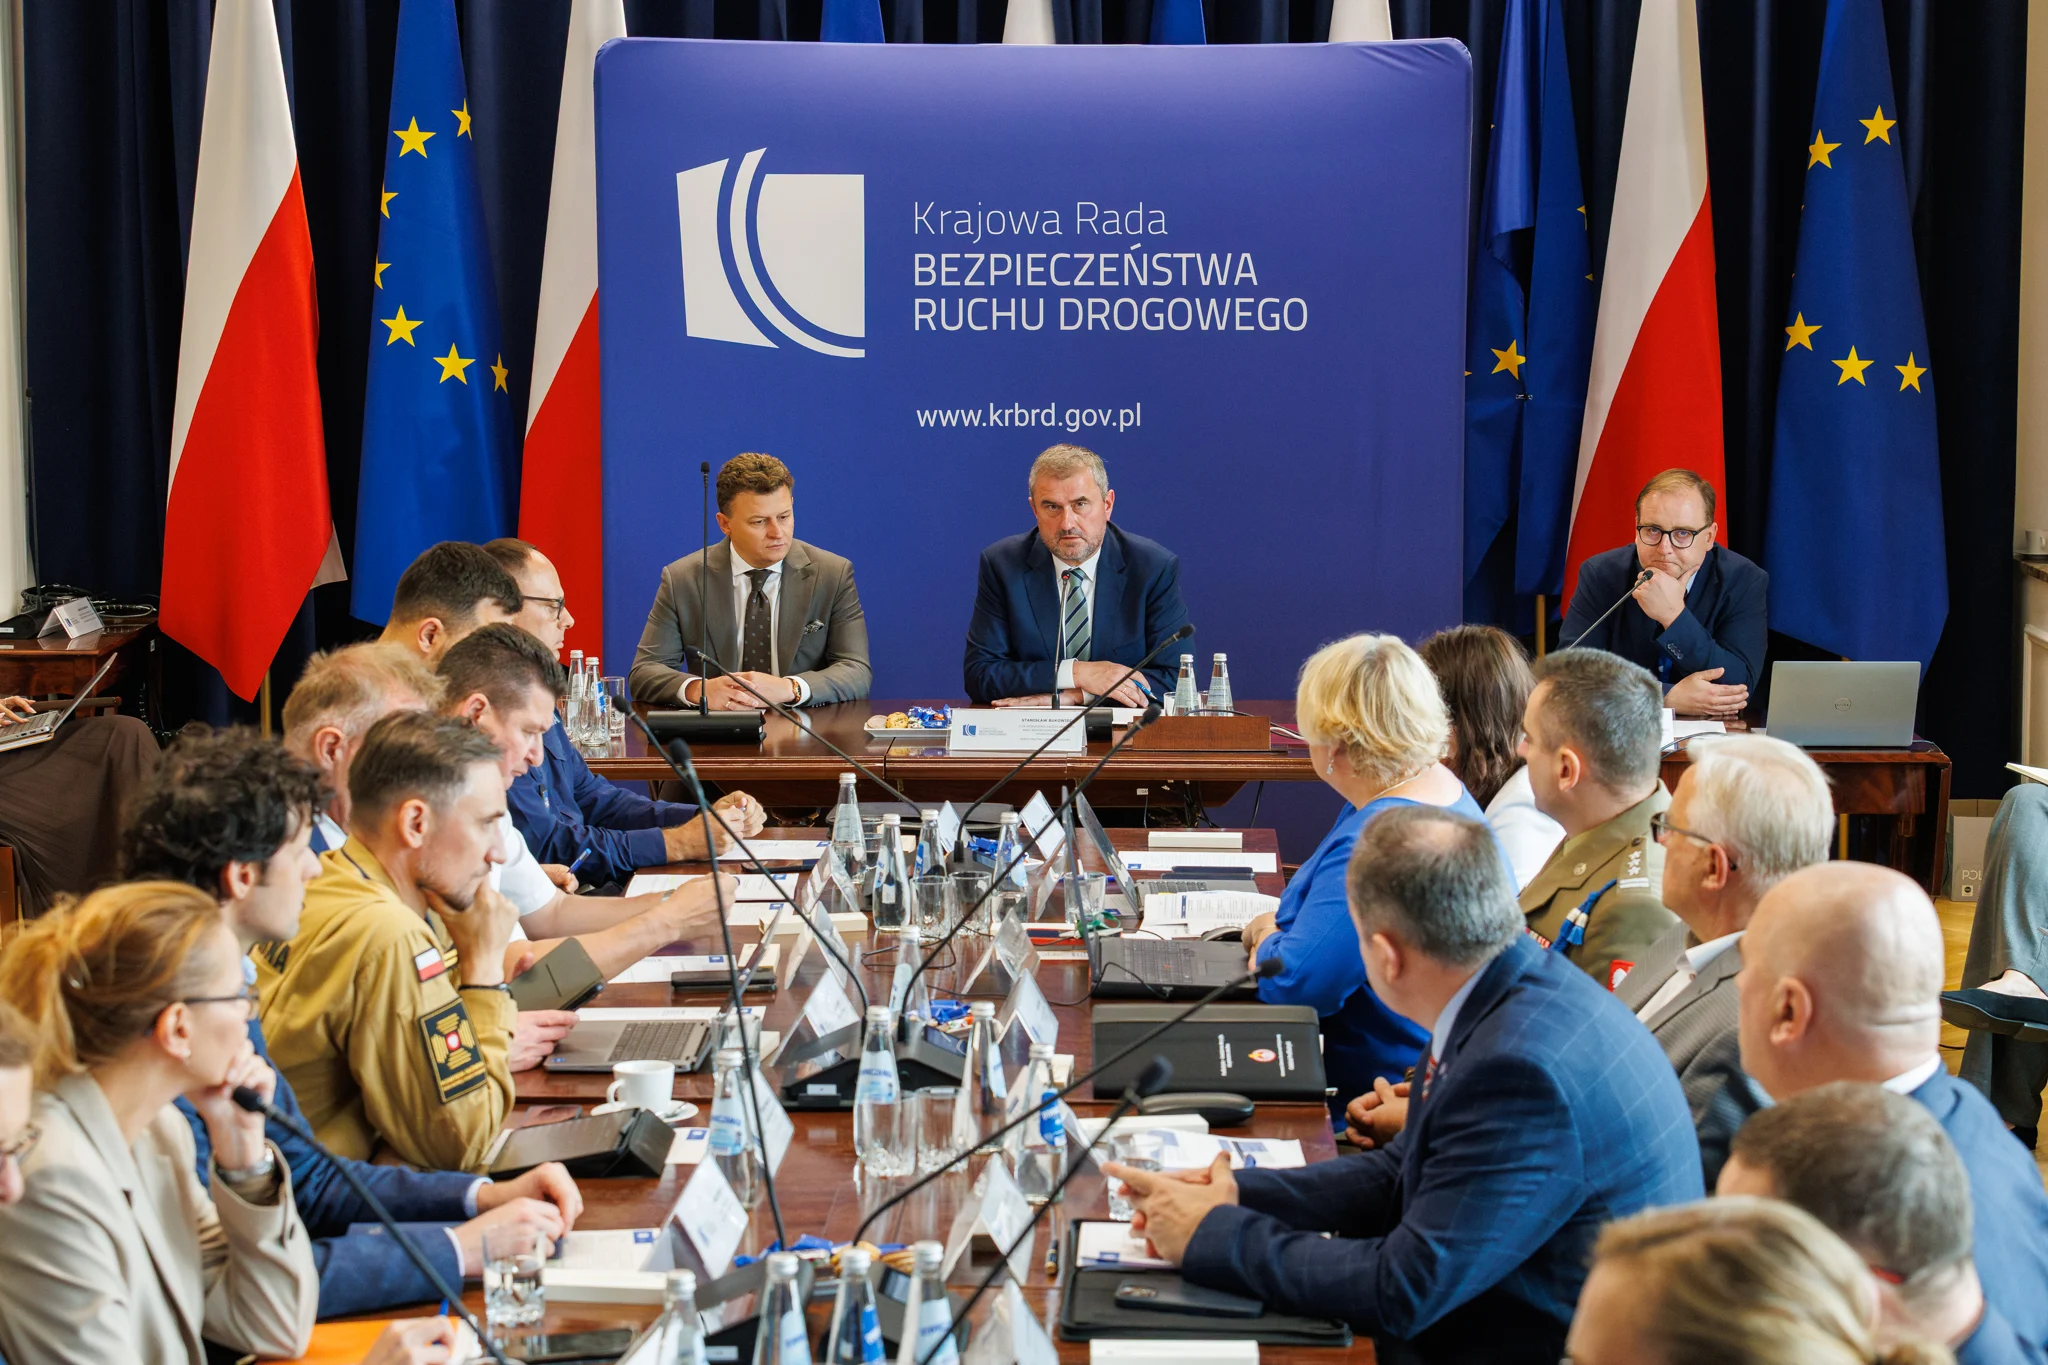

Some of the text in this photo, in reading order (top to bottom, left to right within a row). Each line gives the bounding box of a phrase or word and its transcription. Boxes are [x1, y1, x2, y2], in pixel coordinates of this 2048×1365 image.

[914, 201, 1169, 244] Krajowa Rada
[914, 242, 1259, 287] BEZPIECZEŃSTWA
[914, 297, 1309, 332] RUCHU DROGOWEGO
[916, 402, 1142, 433] www.krbrd.gov.pl
